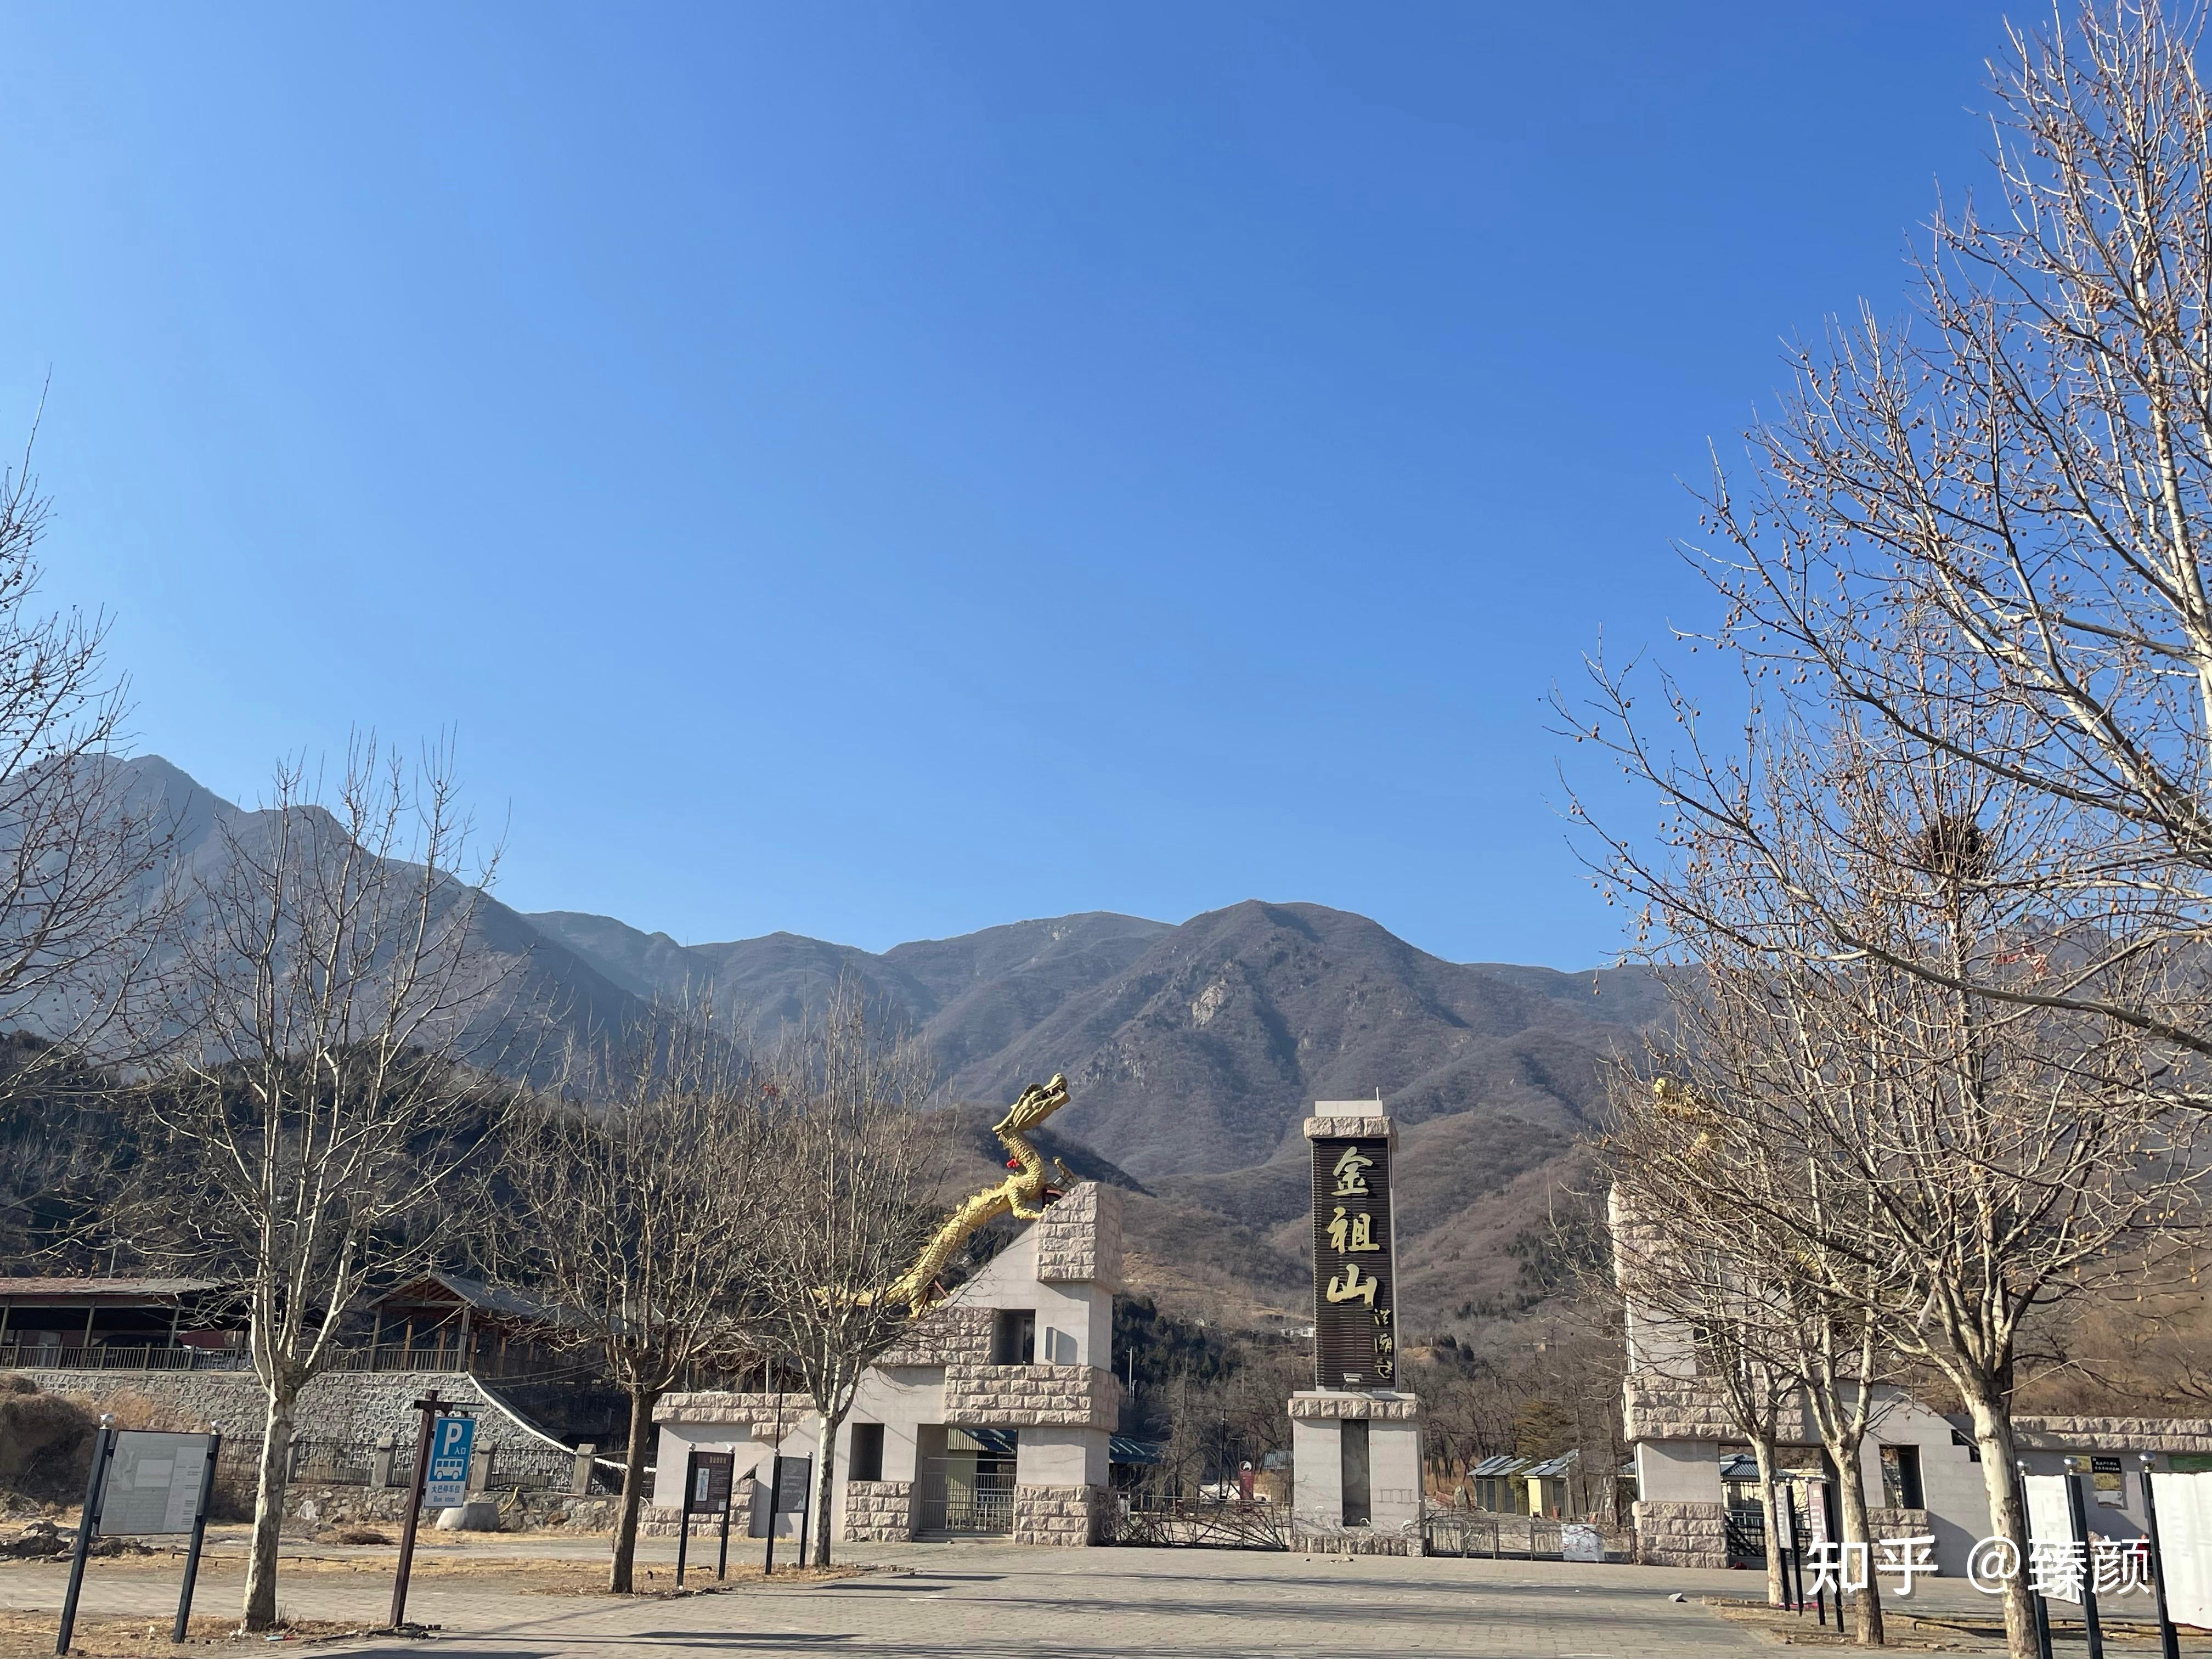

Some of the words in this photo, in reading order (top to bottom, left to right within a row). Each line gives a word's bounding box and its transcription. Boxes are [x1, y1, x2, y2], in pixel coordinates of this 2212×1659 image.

[1325, 1146, 1380, 1310] 金祖山
[443, 1423, 463, 1455] P
[454, 1447, 466, 1455] 入口
[431, 1485, 460, 1493] 大巴停车位
